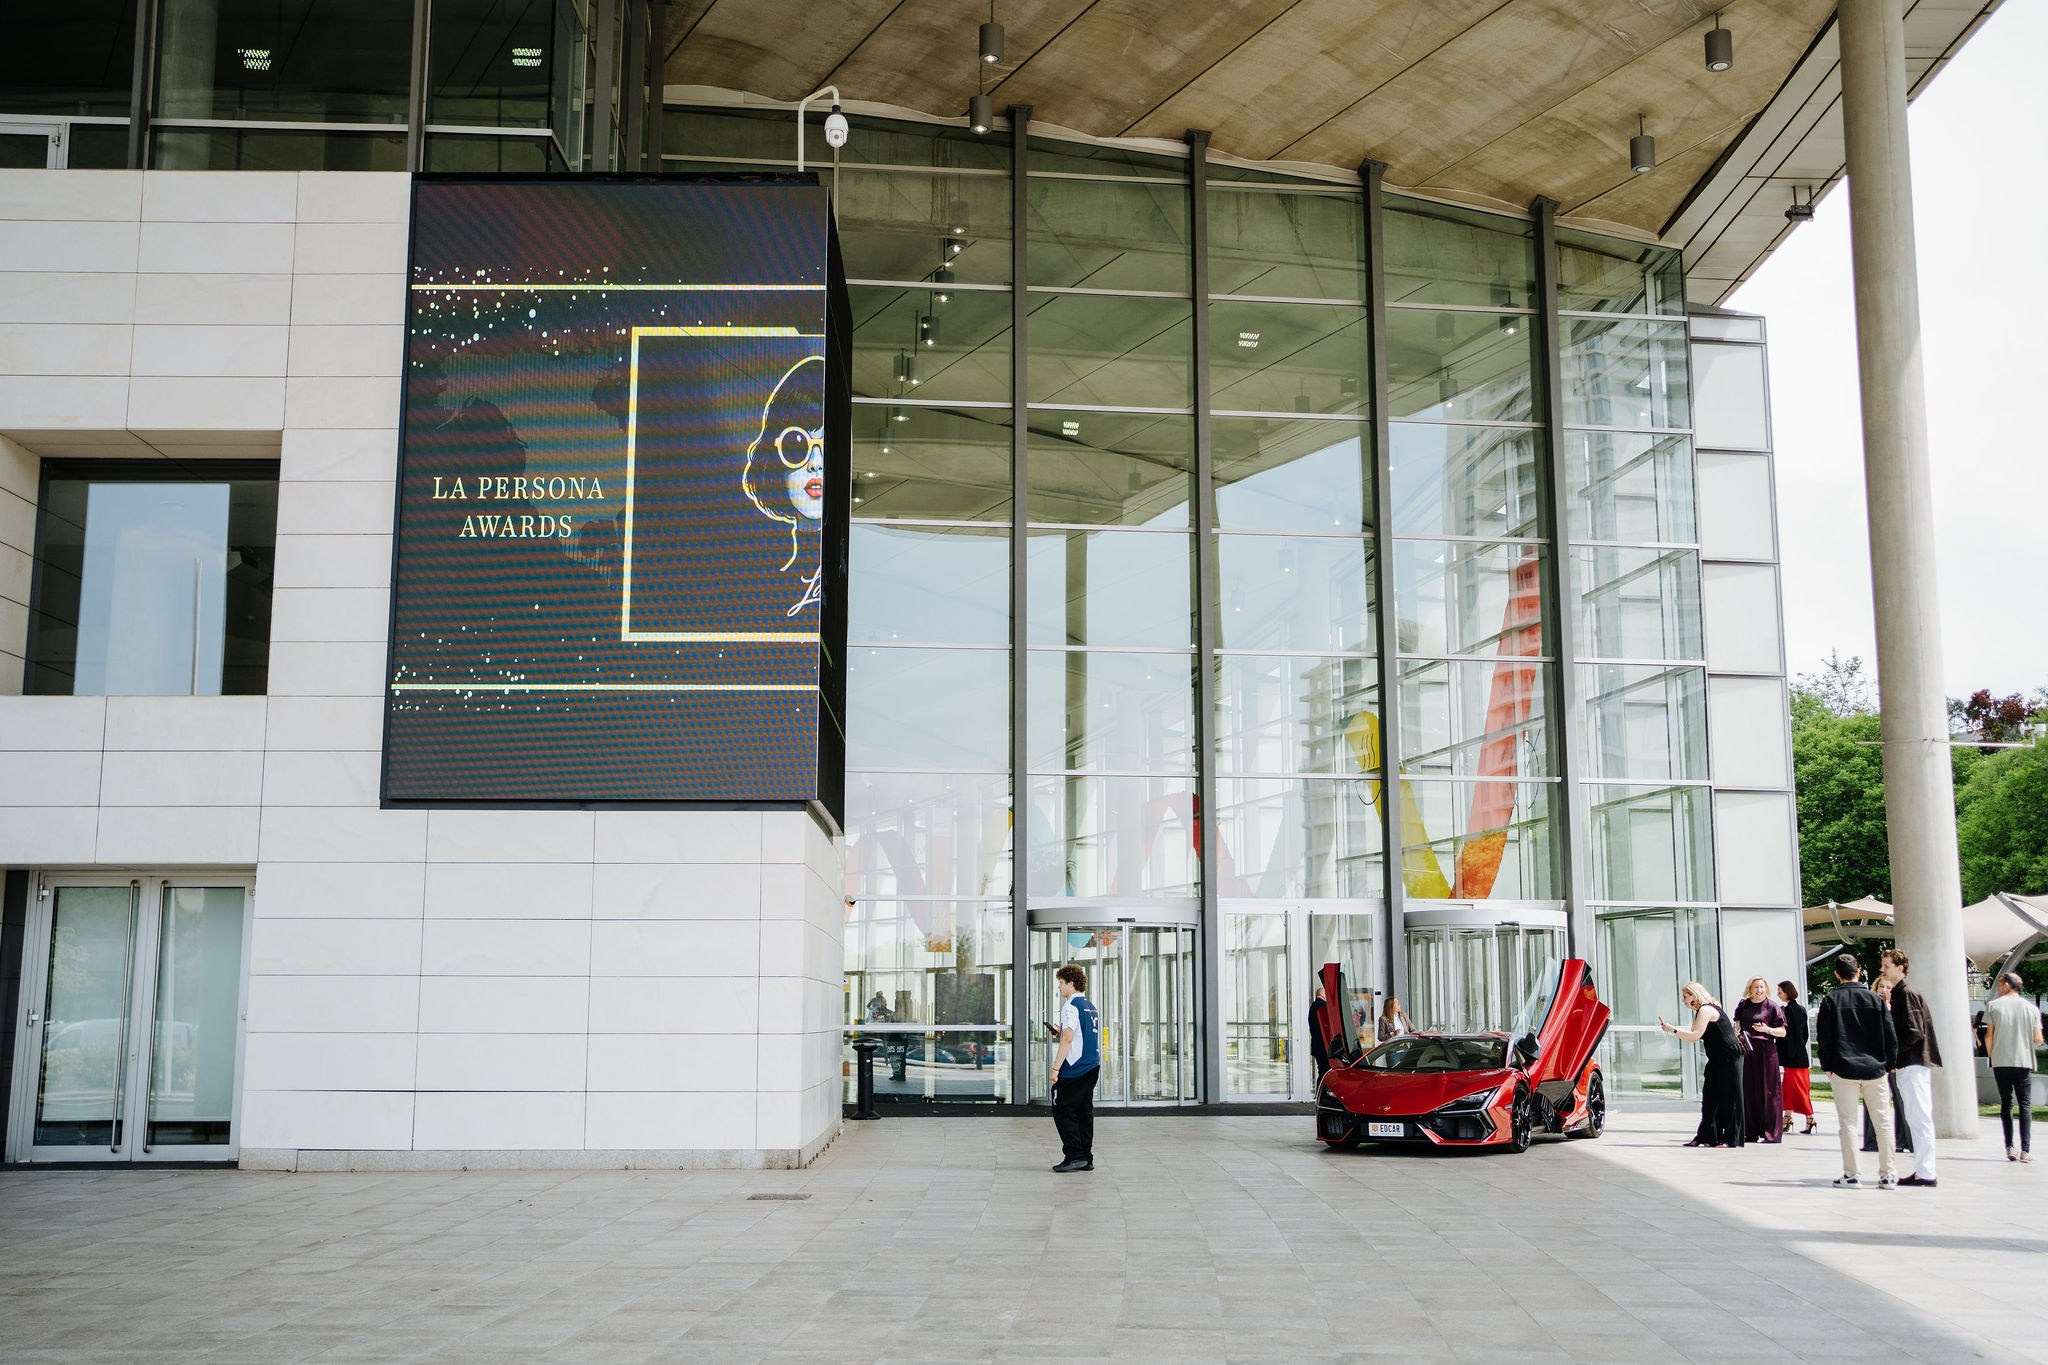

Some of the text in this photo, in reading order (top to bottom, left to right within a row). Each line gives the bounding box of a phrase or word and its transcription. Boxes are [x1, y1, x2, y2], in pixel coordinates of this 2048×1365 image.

[432, 476, 605, 500] LA PERSONA
[458, 515, 572, 538] AWARDS
